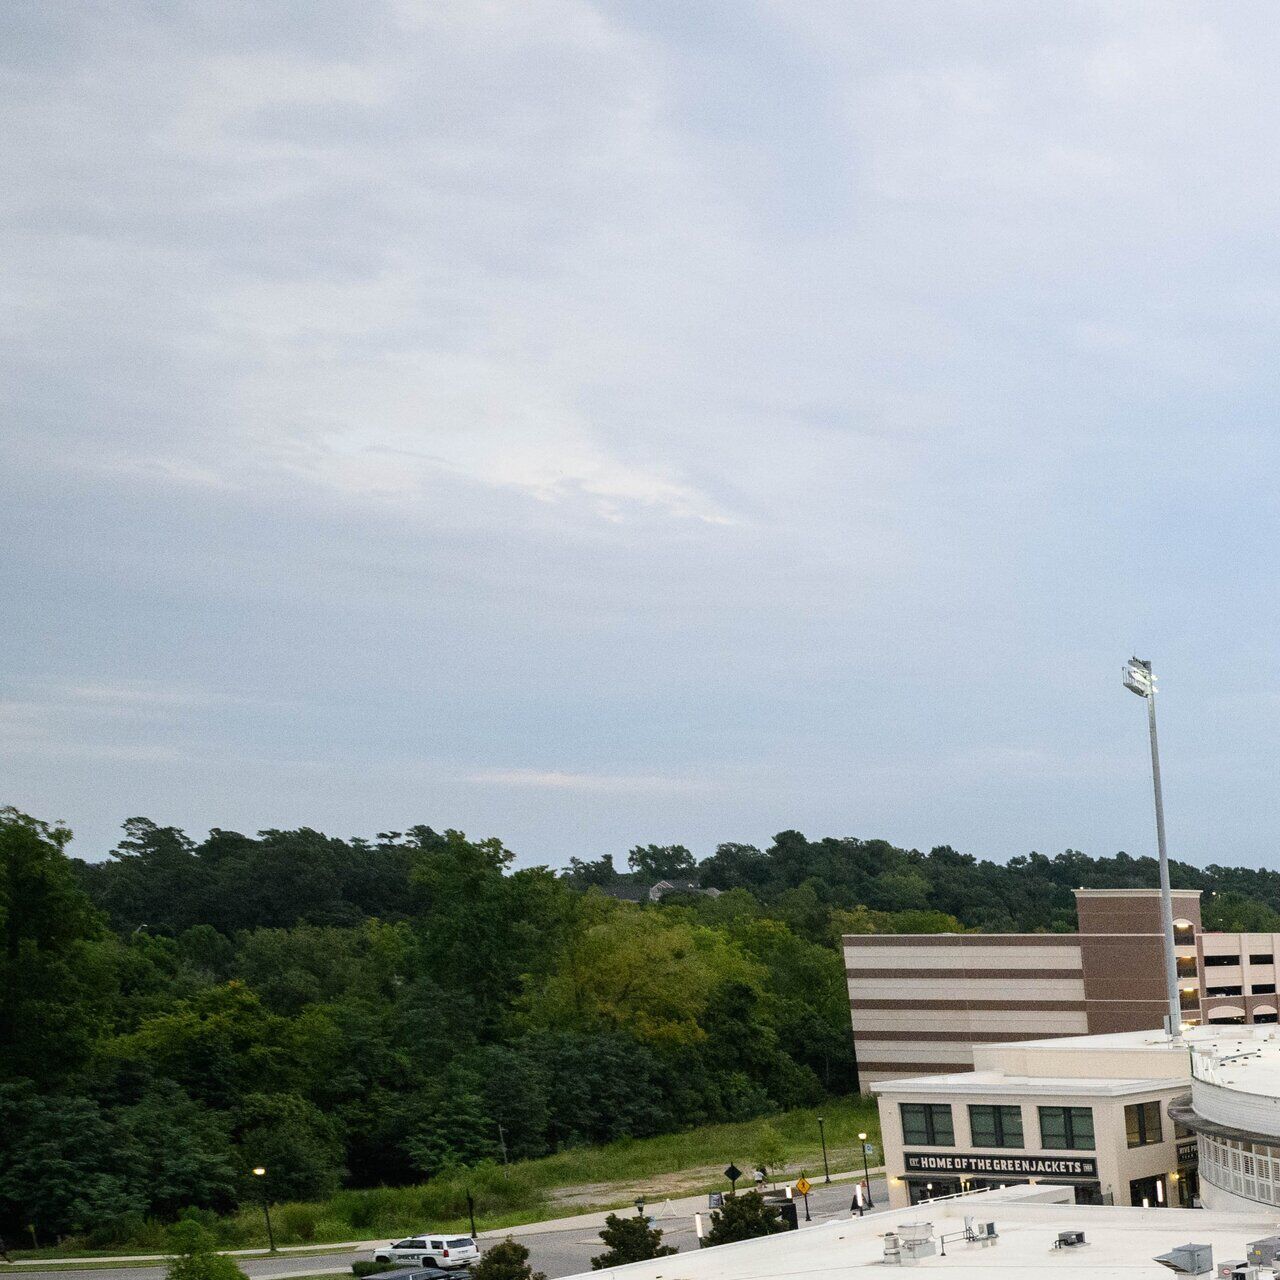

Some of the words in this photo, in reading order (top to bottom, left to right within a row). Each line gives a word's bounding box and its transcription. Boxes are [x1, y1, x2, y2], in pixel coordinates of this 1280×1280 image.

[920, 1157, 953, 1169] HOME
[954, 1158, 968, 1169] OF
[969, 1158, 993, 1171] THE
[993, 1159, 1082, 1173] GREENJACKETS
